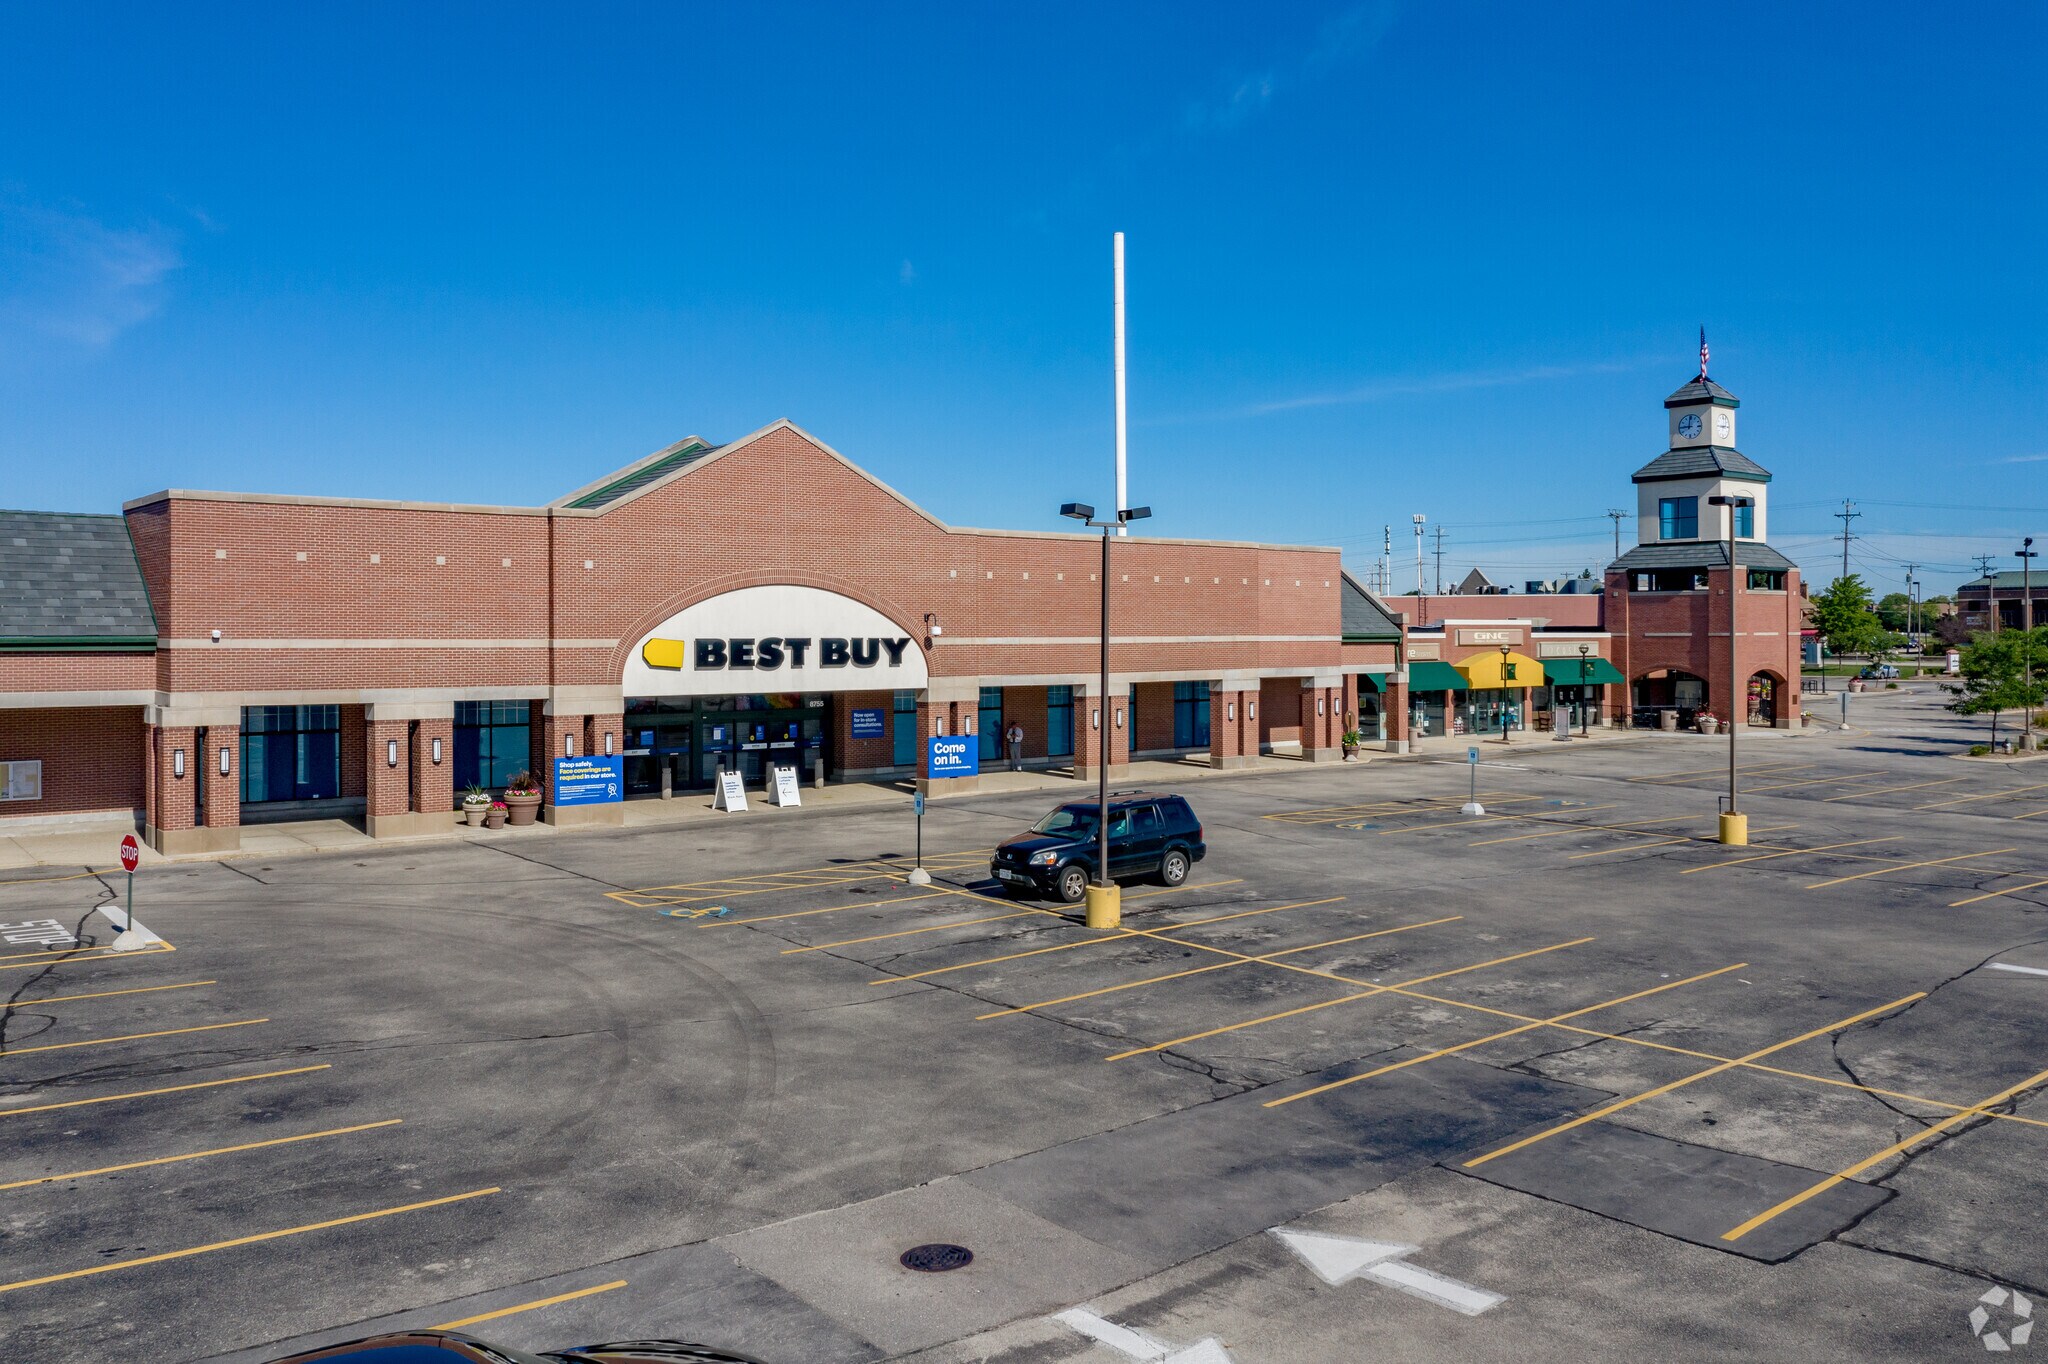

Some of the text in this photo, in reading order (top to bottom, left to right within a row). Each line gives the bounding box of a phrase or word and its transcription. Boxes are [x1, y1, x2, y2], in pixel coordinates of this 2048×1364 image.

[694, 637, 911, 671] BEST BUY
[934, 742, 965, 754] Come
[934, 753, 962, 765] on in.
[121, 844, 138, 861] STOP
